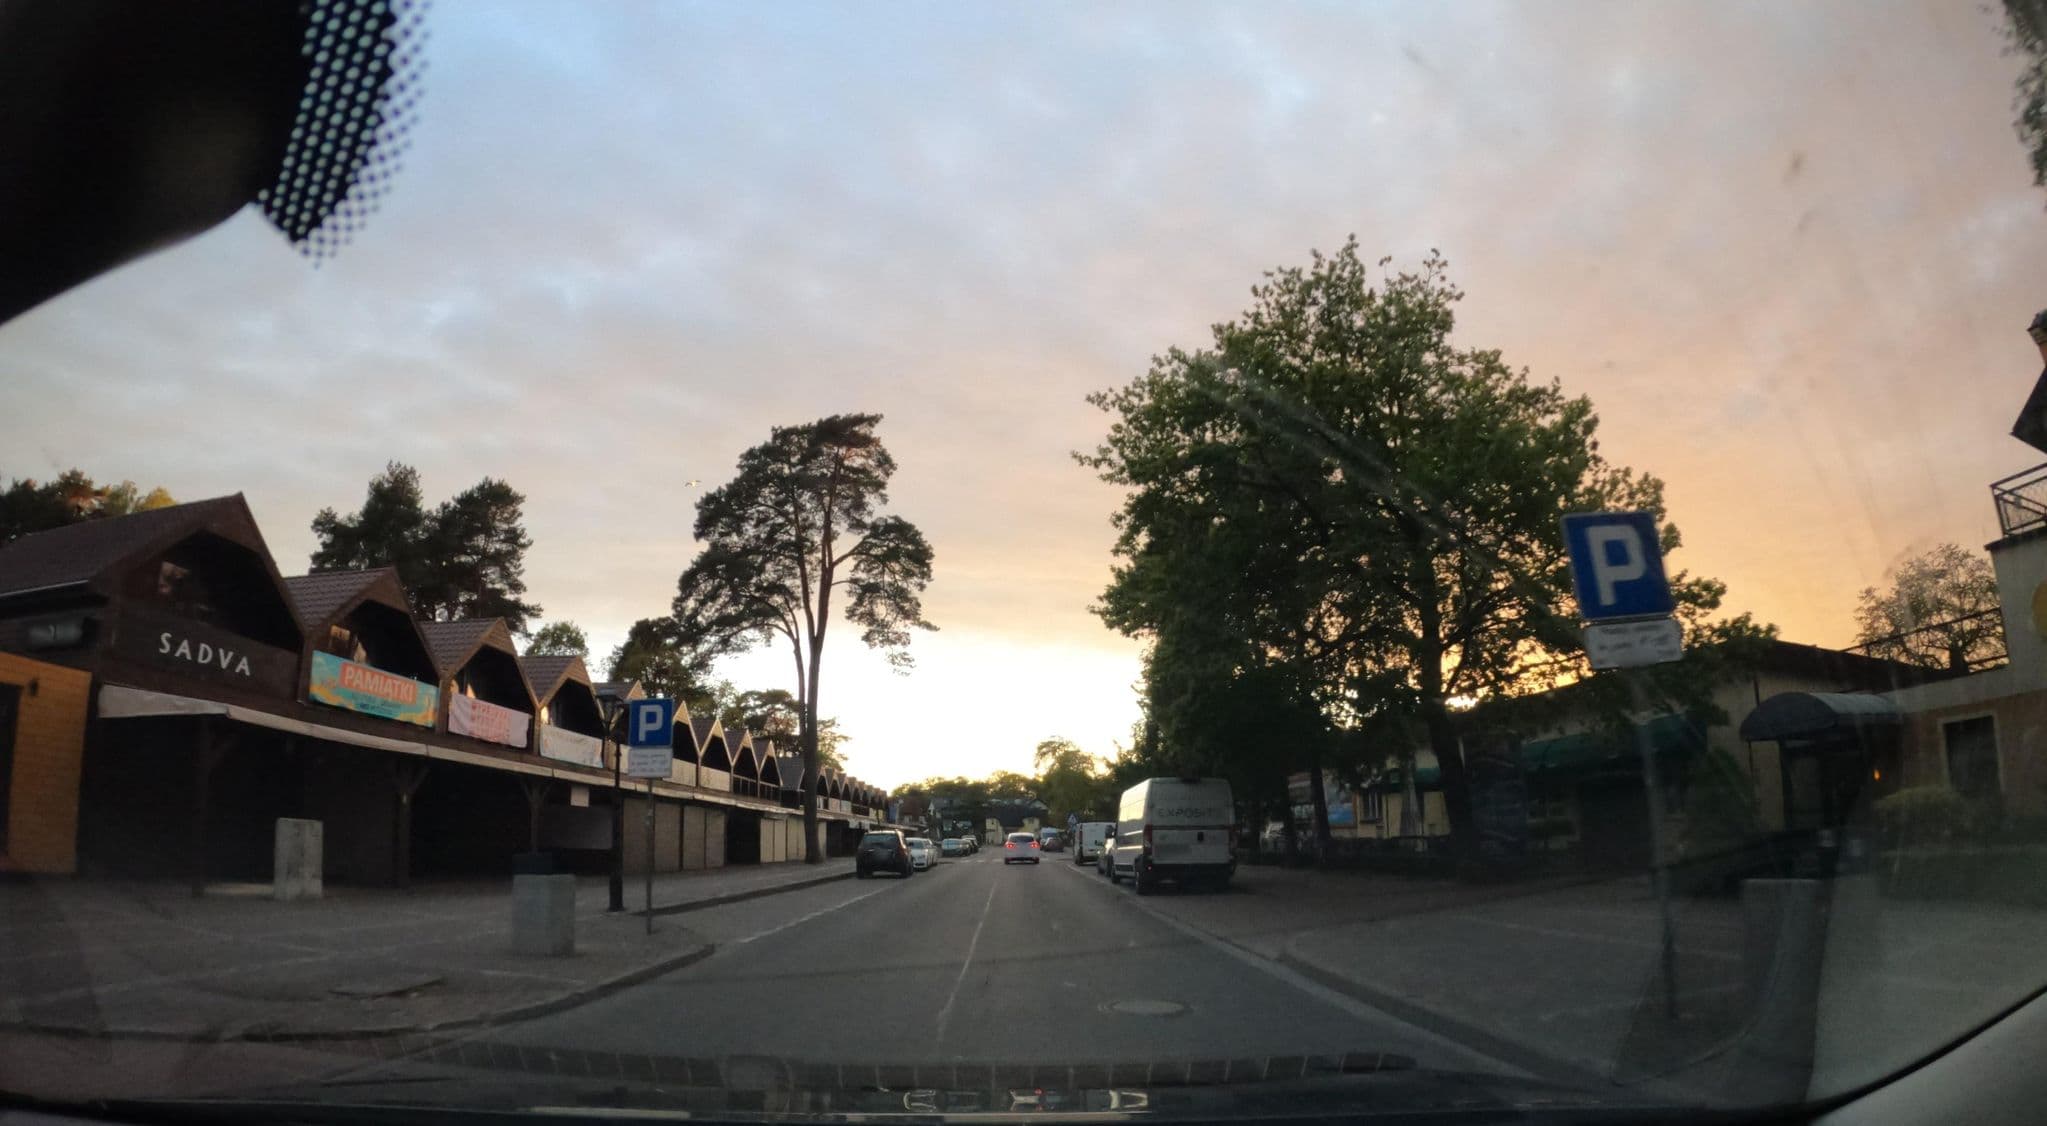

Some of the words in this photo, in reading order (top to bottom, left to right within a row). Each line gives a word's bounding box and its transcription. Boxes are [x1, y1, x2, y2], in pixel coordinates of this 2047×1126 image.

[1587, 525, 1646, 605] P
[159, 632, 251, 676] SADVA
[638, 704, 664, 742] P
